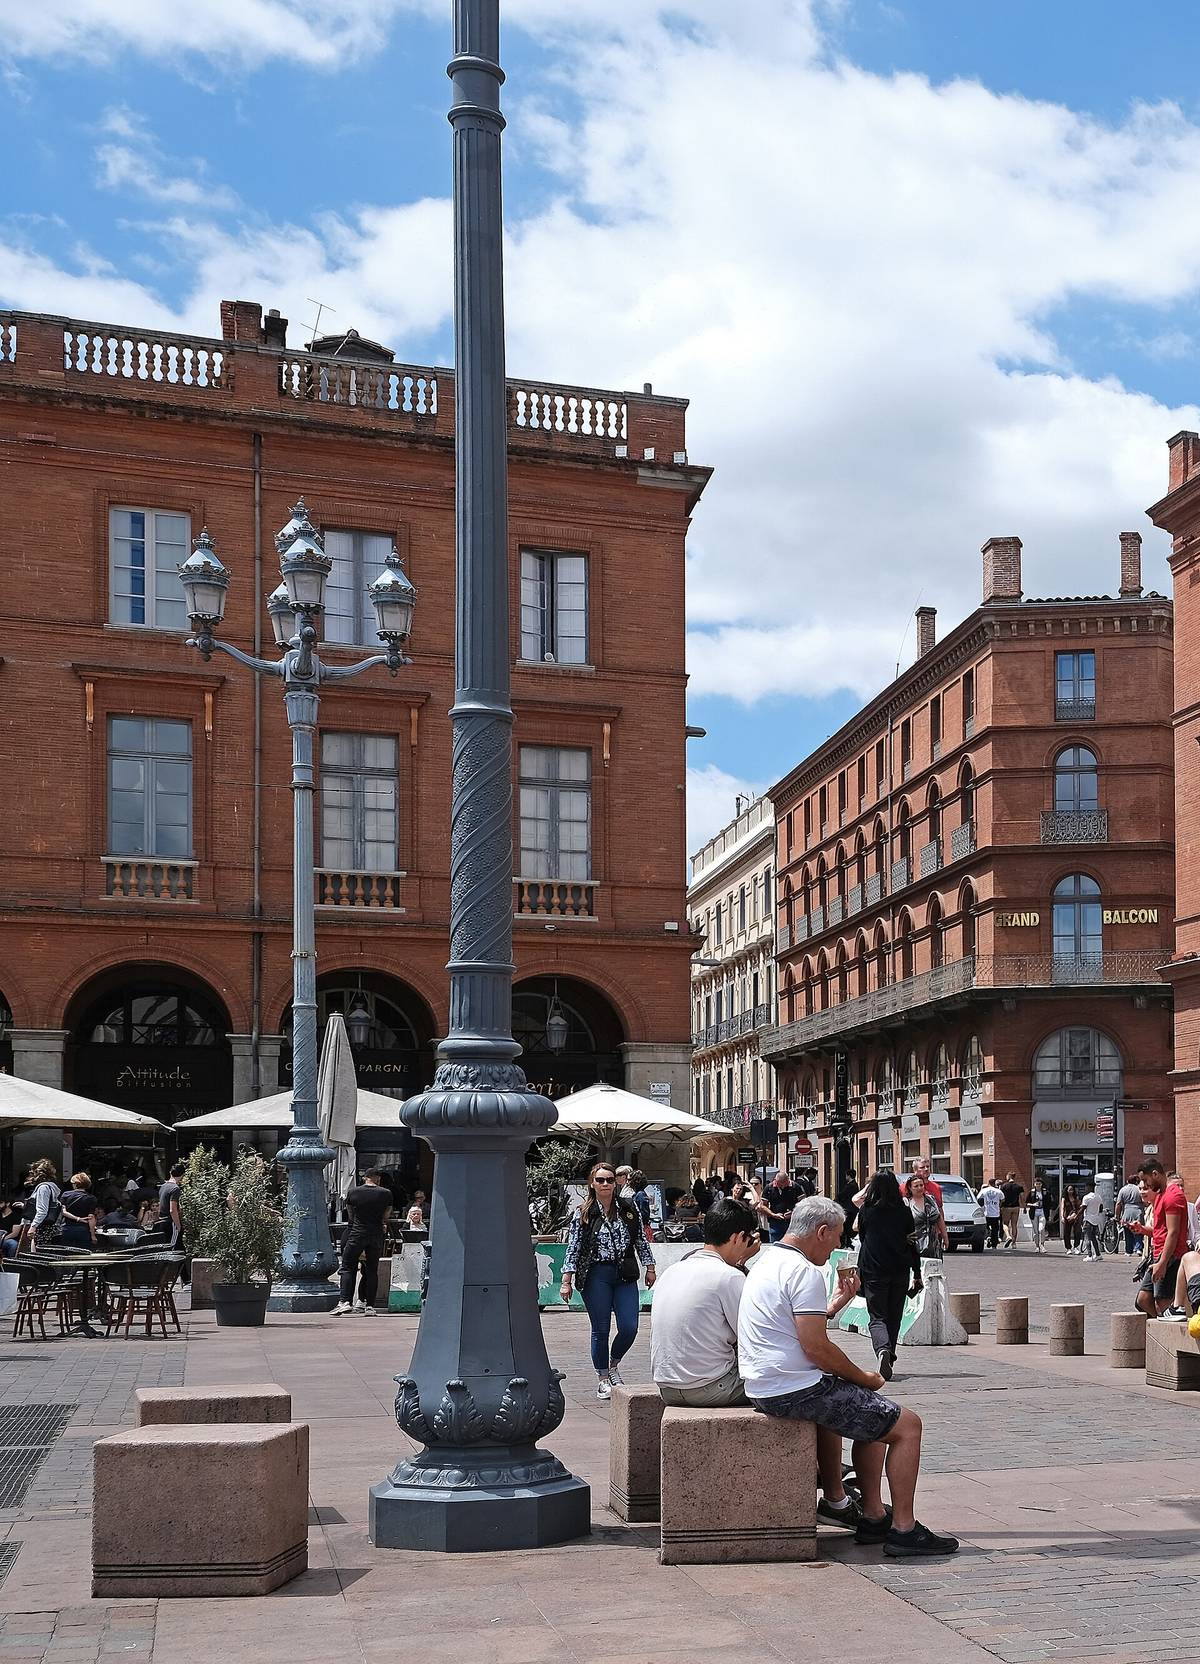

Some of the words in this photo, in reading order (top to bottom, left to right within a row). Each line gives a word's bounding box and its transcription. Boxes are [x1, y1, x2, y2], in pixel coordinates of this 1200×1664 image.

[994, 912, 1040, 927] GRAND
[1103, 909, 1158, 925] BALCON
[116, 1066, 191, 1079] Attitude
[355, 1064, 409, 1073] PARGNE
[116, 1080, 192, 1088] Diffusion
[526, 1077, 583, 1099] erin
[1038, 1119, 1071, 1132] Club
[1072, 1119, 1097, 1132] Me
